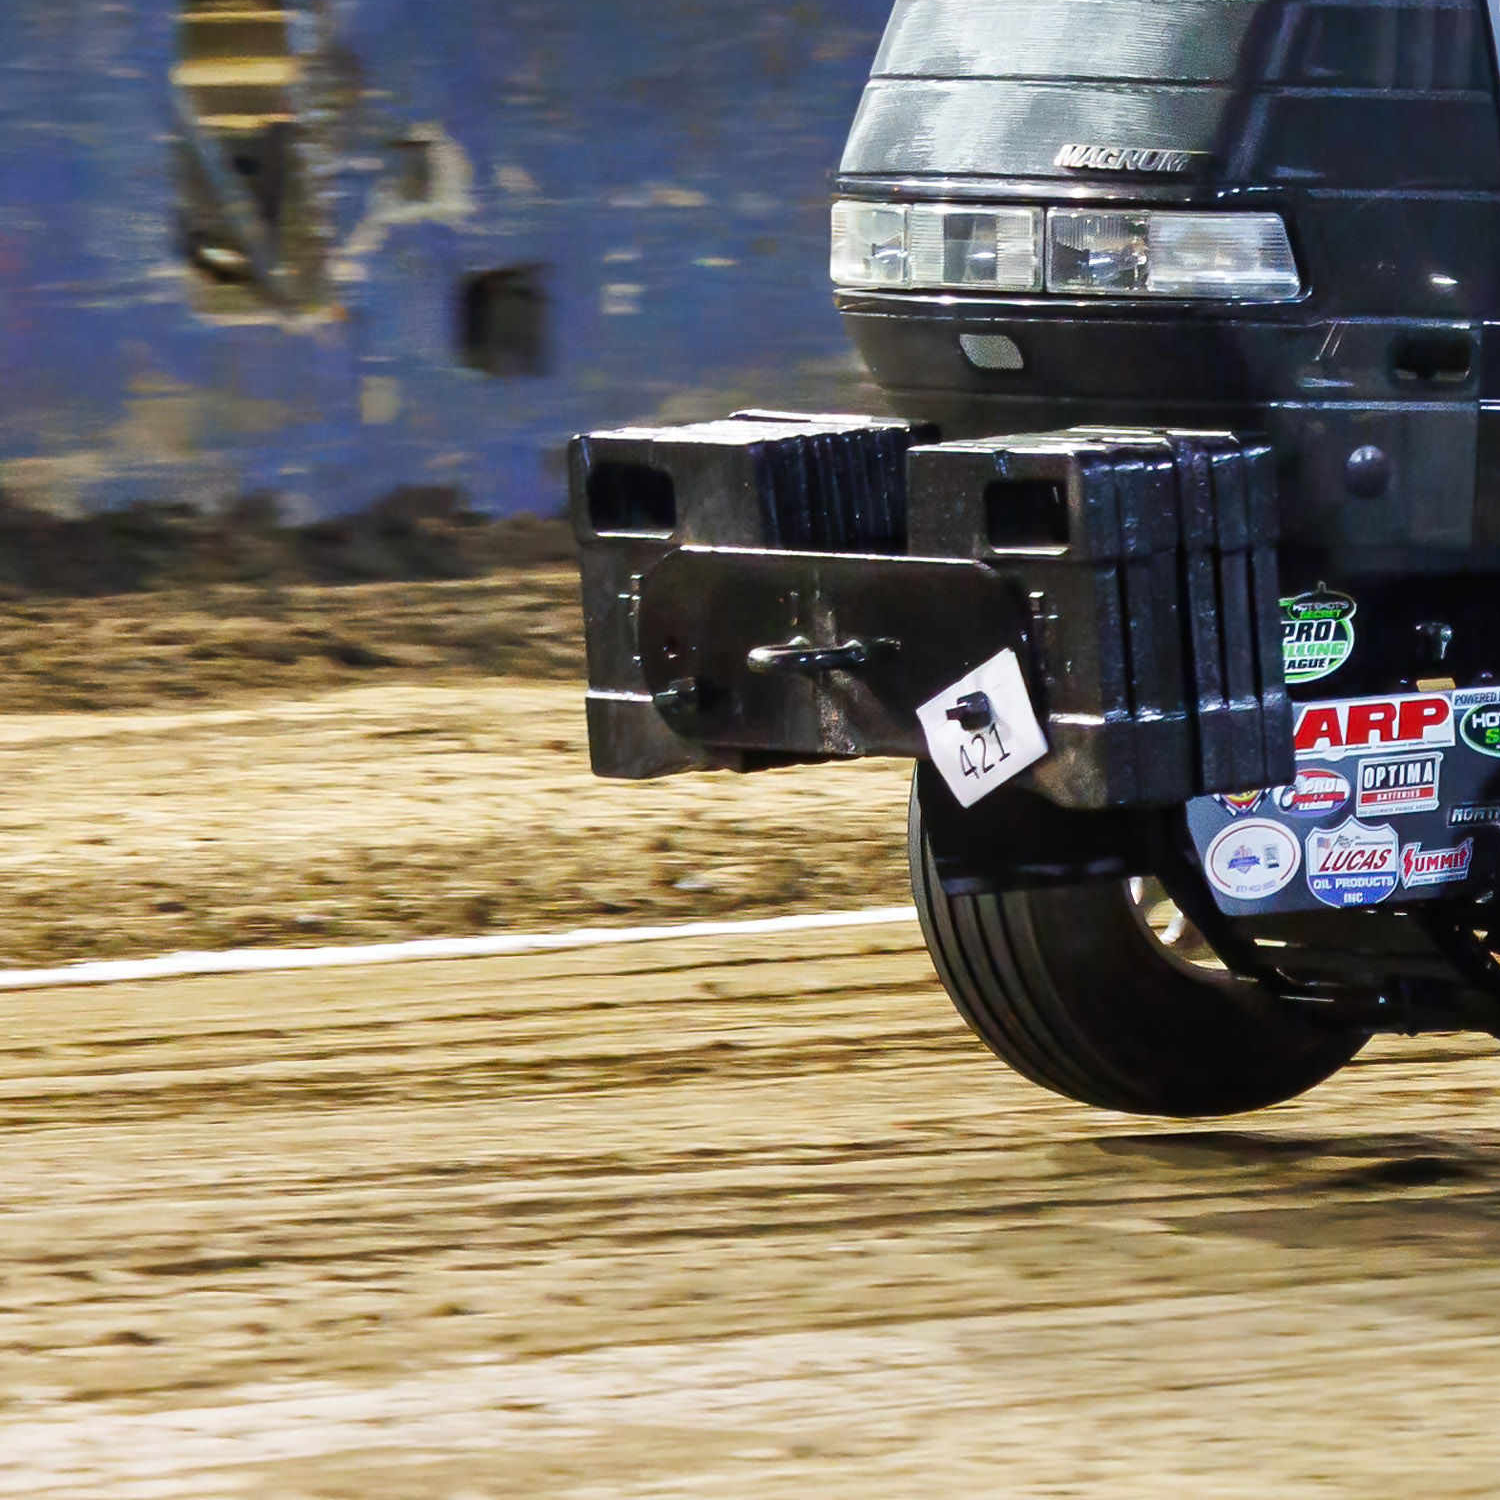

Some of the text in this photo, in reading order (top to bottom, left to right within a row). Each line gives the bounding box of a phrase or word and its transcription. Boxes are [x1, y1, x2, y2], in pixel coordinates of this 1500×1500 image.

[1054, 144, 1191, 172] MAGNUM
[1281, 621, 1332, 643] PRO
[1455, 692, 1497, 706] POWERED
[1295, 698, 1450, 750] ARP
[959, 722, 1011, 780] 421
[1363, 761, 1433, 789] OPTIMA
[1318, 848, 1392, 873] LUCAS
[1403, 847, 1468, 880] SUMMIT
[1313, 875, 1394, 889] OIL PRODUCTS
[1344, 893, 1364, 904] INC
